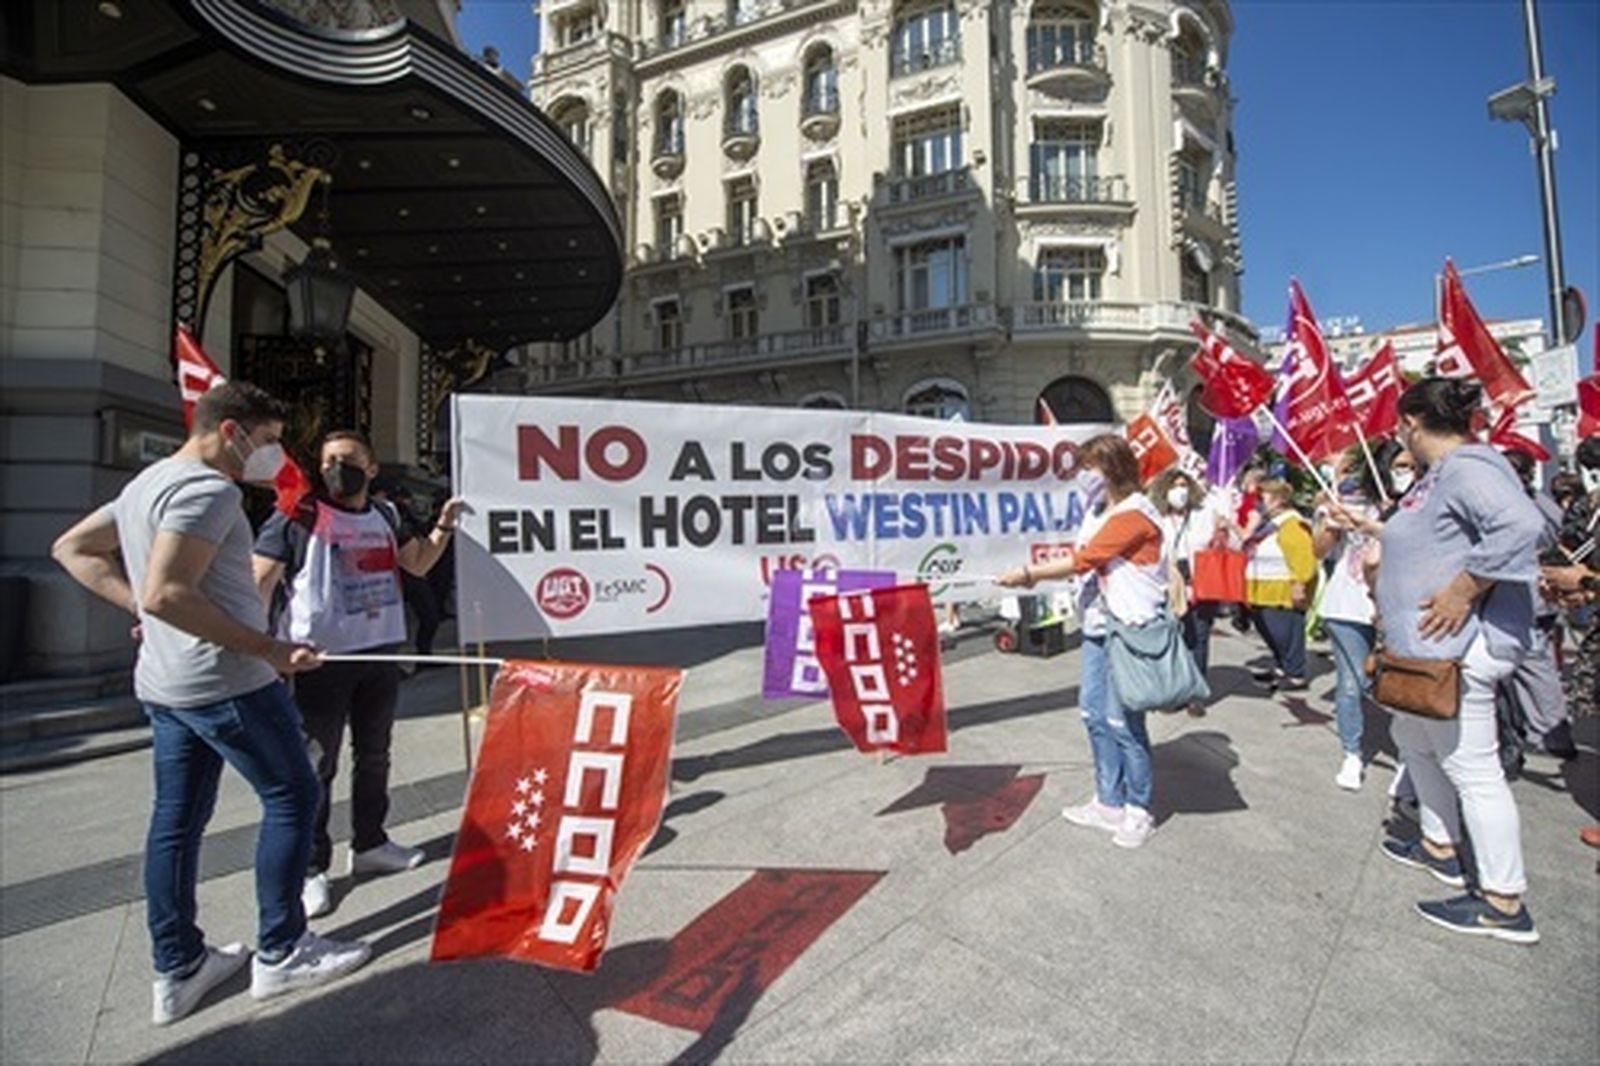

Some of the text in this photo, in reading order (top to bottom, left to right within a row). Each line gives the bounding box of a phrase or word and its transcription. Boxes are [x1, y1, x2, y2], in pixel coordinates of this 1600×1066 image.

[517, 424, 648, 482] NO
[669, 440, 716, 481] A
[731, 441, 834, 481] LOS
[488, 509, 557, 553] EN
[569, 509, 625, 550] EL
[639, 495, 815, 547] HOTEL
[825, 492, 989, 541] WESTIN
[538, 690, 633, 944] CCOO
